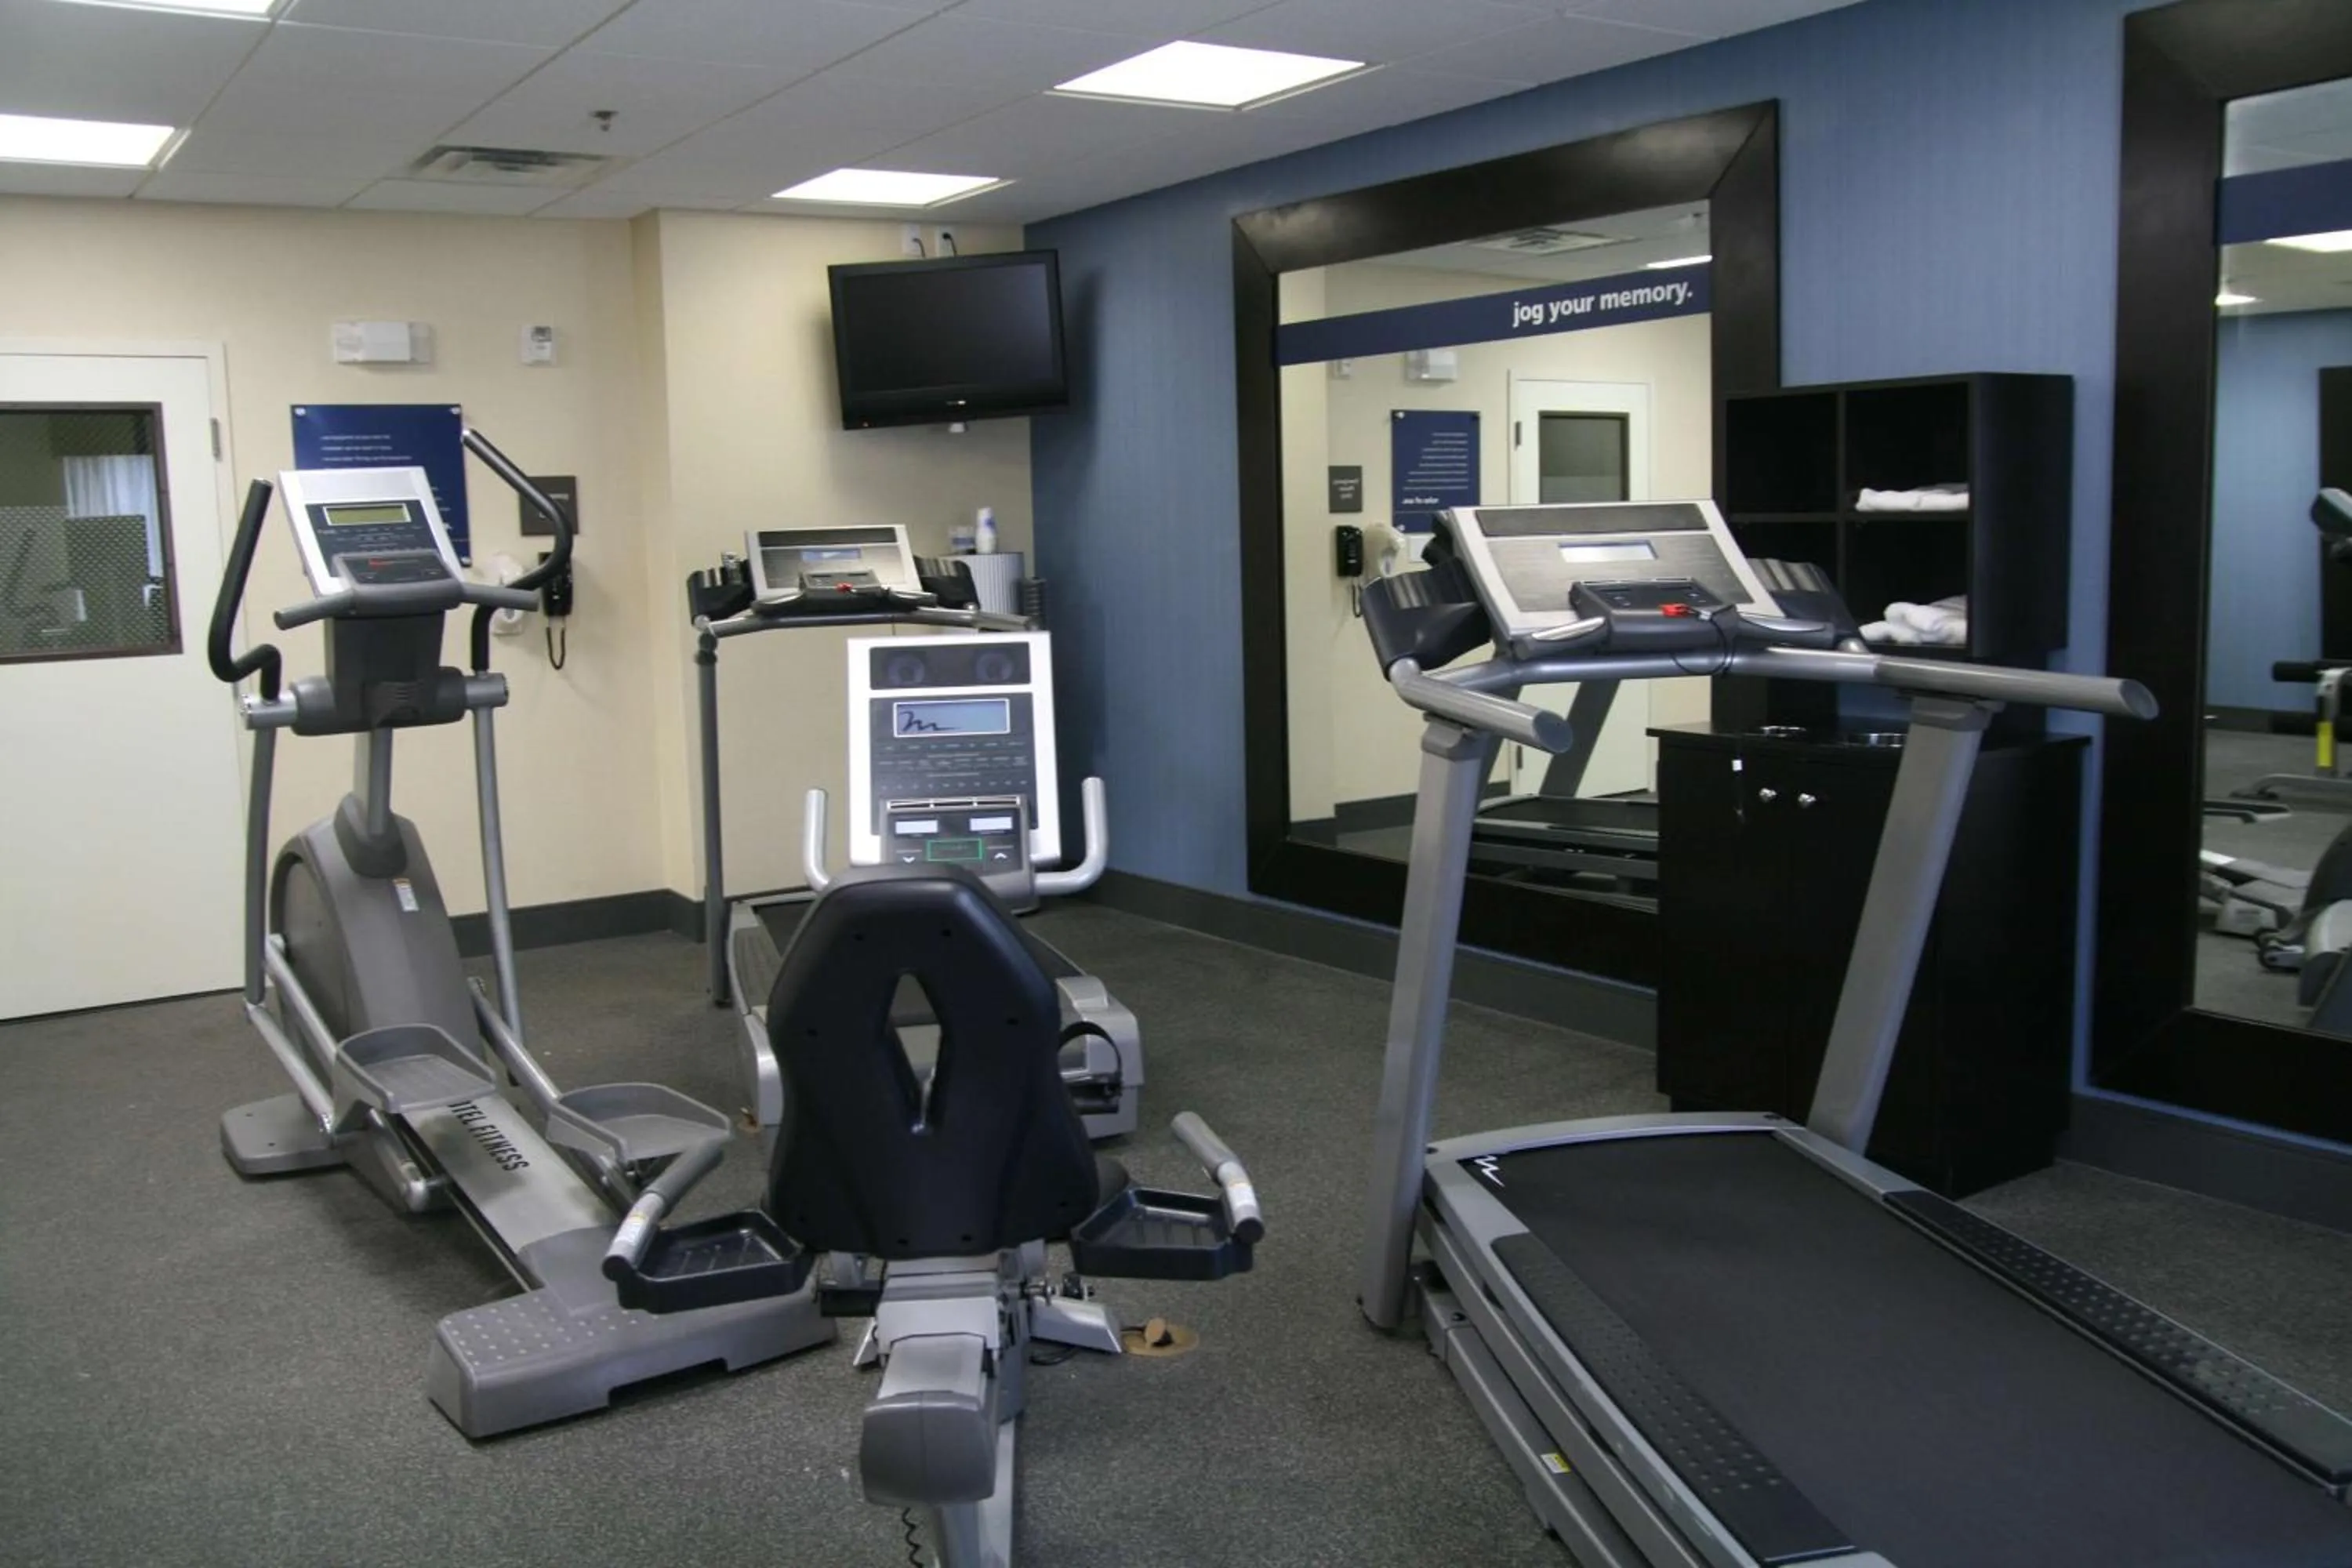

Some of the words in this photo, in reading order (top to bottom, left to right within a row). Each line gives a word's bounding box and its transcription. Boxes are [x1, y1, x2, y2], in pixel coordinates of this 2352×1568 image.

[1512, 302, 1544, 328] jog
[1549, 294, 1595, 323] your
[1600, 281, 1693, 310] memory.
[468, 1124, 530, 1171] FITNESS
